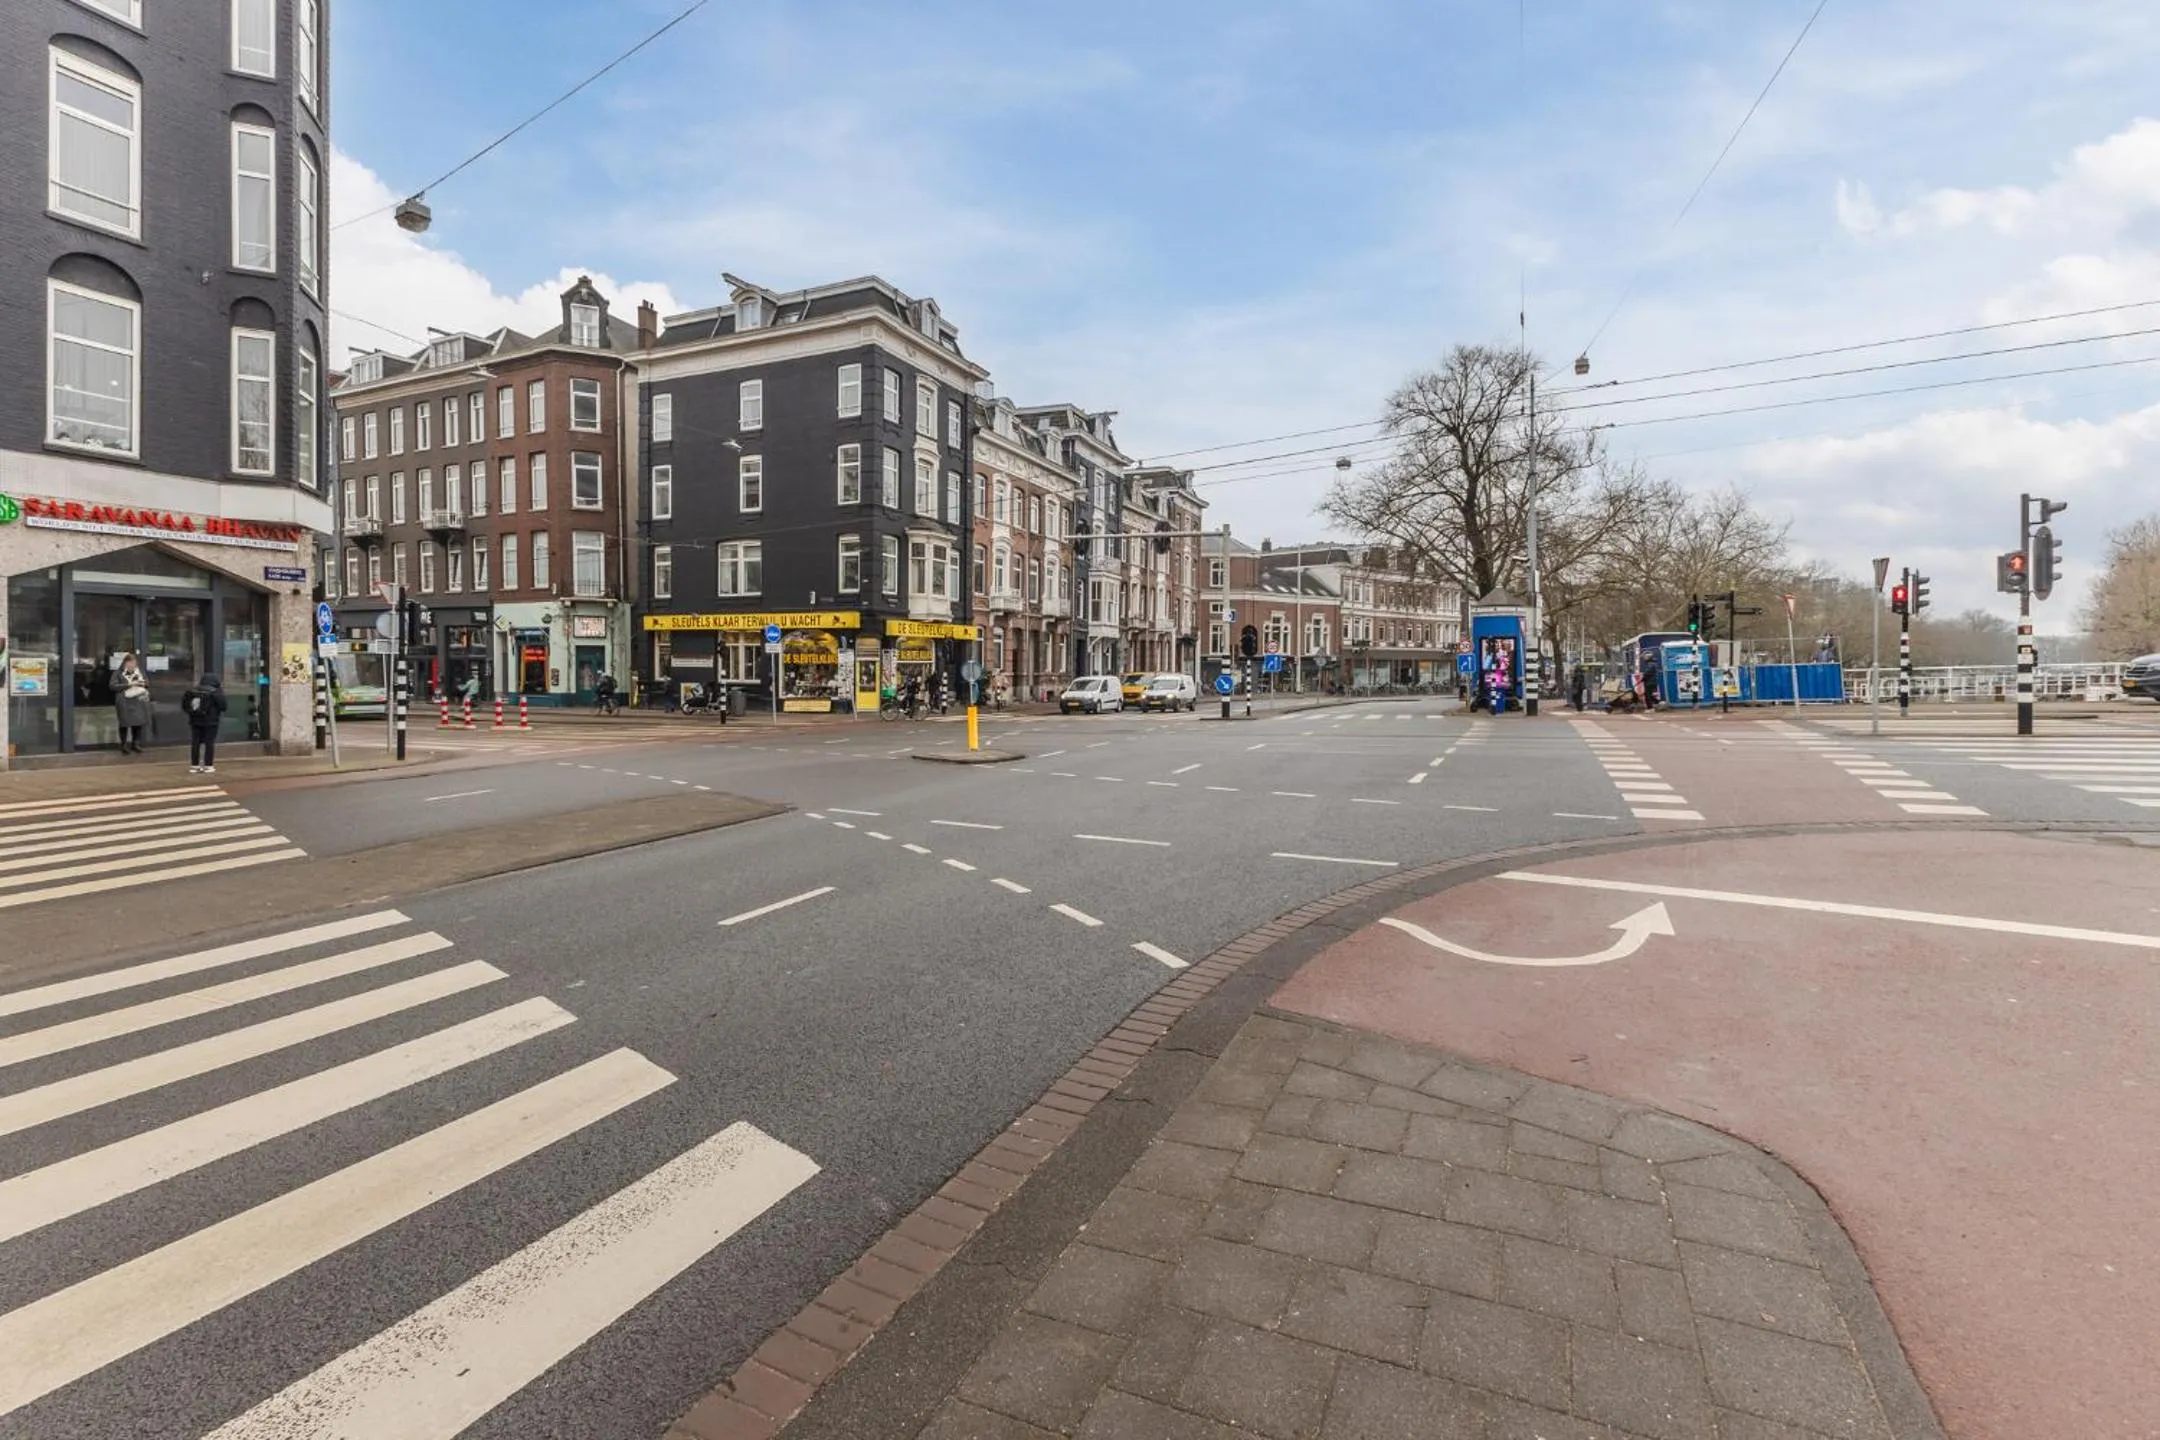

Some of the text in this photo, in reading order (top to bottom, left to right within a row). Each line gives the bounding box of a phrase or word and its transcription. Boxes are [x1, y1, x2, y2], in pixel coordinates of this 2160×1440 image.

[24, 497, 300, 543] SARAVANAA BHAVAN
[672, 614, 821, 628] SLEUTELS KLAAR TERWIJL U WACHT
[898, 623, 907, 634] DE
